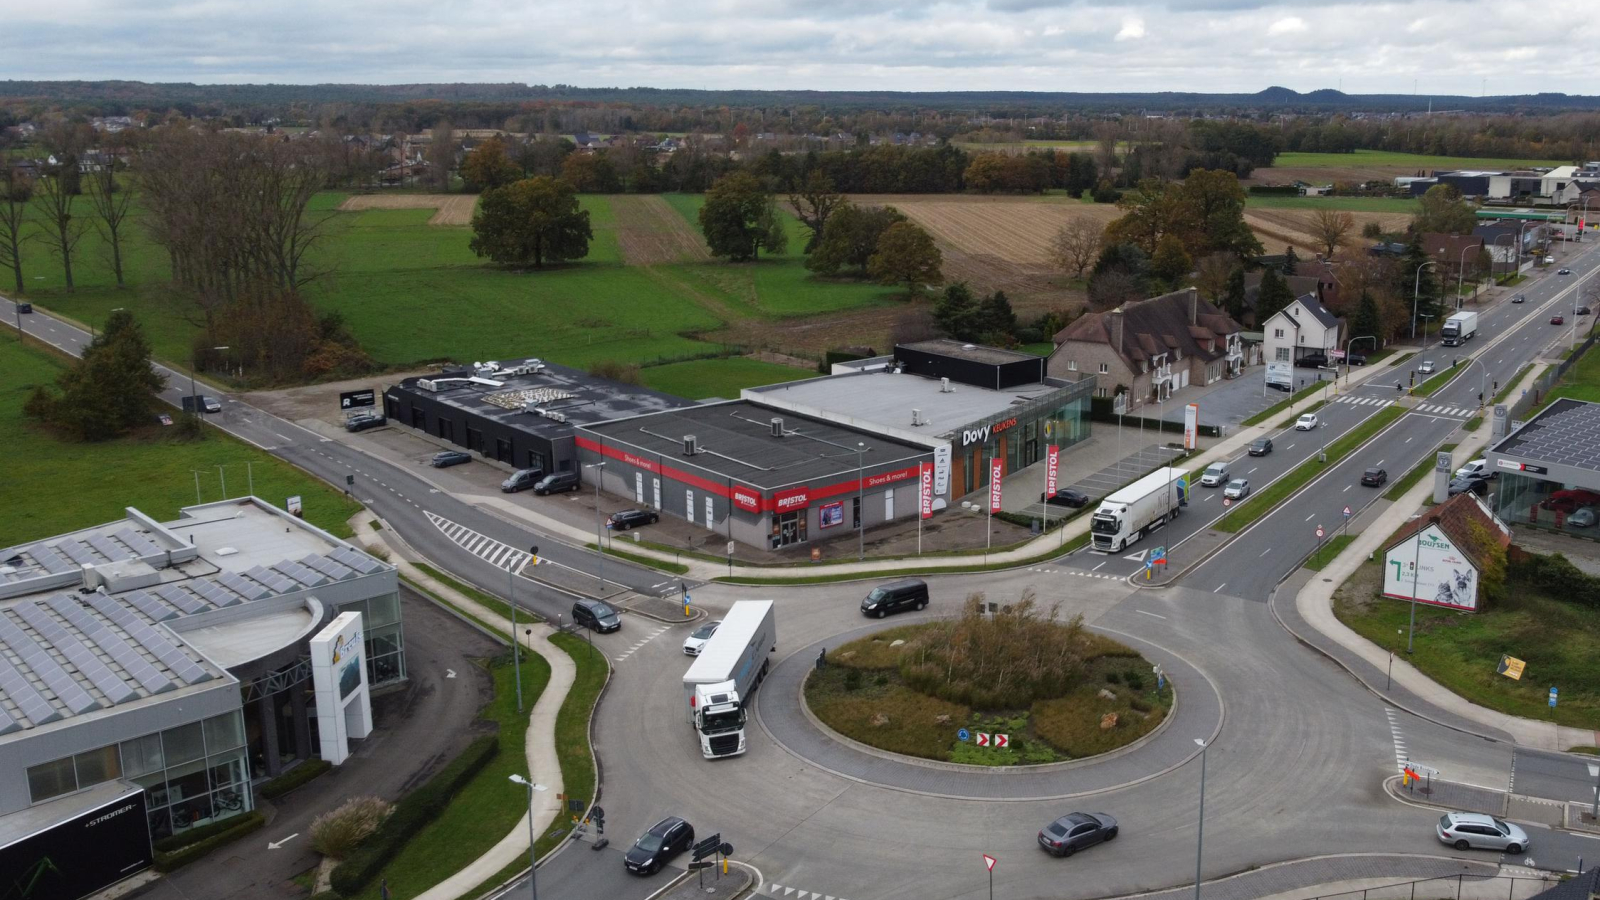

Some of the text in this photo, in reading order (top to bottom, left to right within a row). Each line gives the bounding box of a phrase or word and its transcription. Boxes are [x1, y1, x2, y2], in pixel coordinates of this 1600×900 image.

[992, 417, 1017, 434] KEUKENS
[869, 477, 886, 486] Shoes
[892, 471, 908, 480] more!
[1048, 452, 1058, 494] BRISTOL
[922, 469, 932, 514] BRISTOL
[992, 465, 1002, 509] BRISTOL
[735, 492, 757, 505] BRISTOL
[778, 494, 807, 507] BRISTOL
